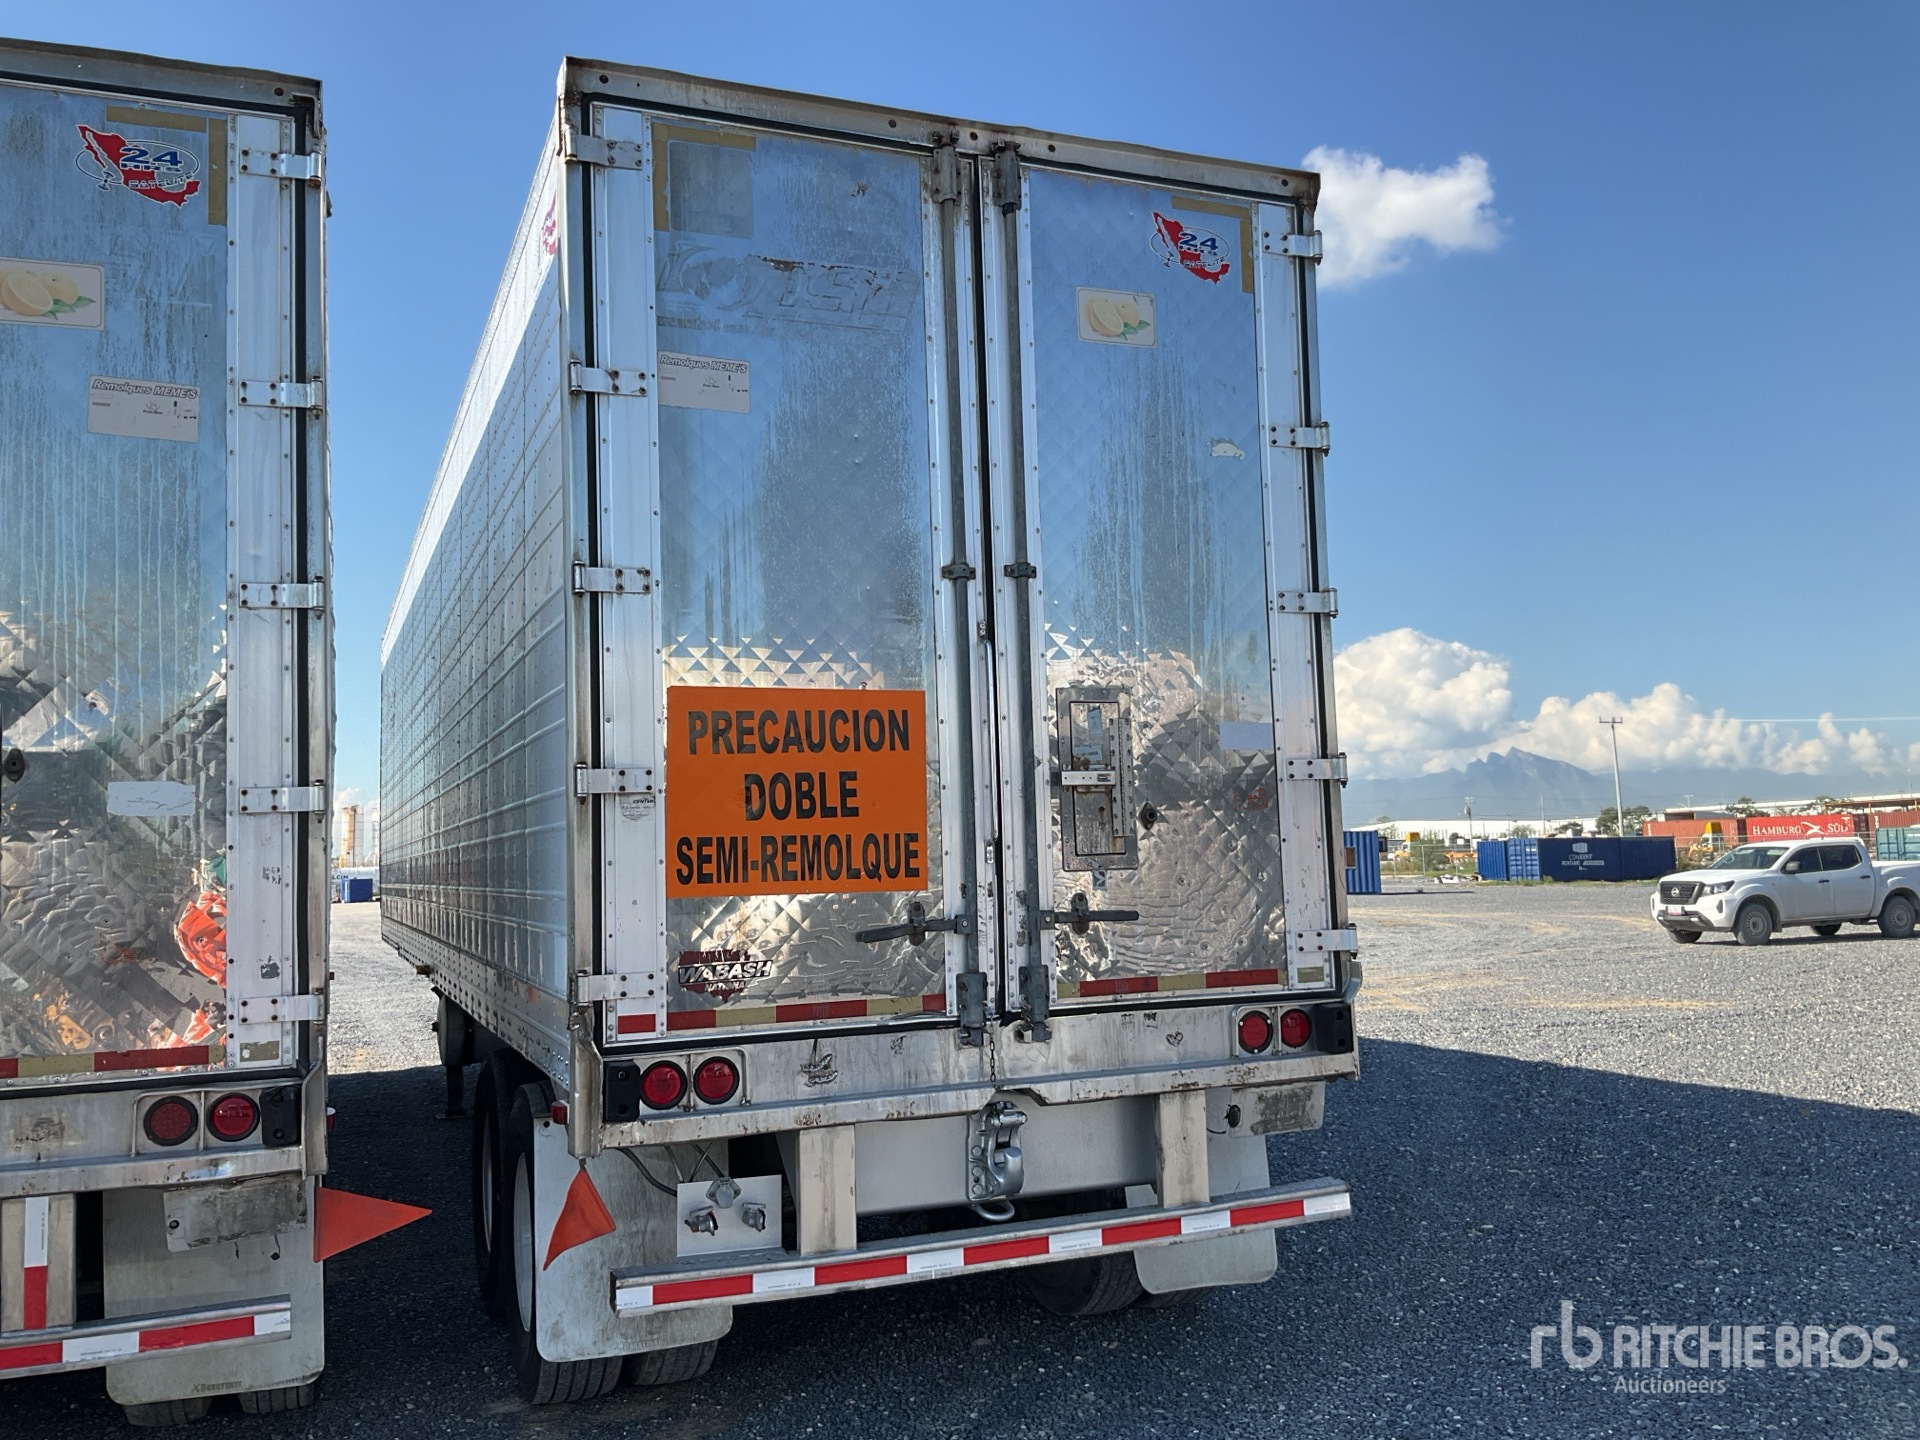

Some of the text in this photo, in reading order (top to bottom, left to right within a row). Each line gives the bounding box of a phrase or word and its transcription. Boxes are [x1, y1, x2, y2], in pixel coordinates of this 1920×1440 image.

[120, 147, 183, 167] 24
[120, 162, 181, 173] HRS
[1178, 232, 1218, 250] 24
[660, 354, 748, 374] Remolques MEME'S
[92, 379, 198, 399] Remolques MEME'S
[688, 708, 910, 756] PRECAUCION
[743, 770, 860, 822] DOBLE
[1752, 823, 1848, 835] HAMBURG SÜD
[675, 832, 921, 886] SEMI-REMOLQUE
[679, 960, 772, 983] WABASH
